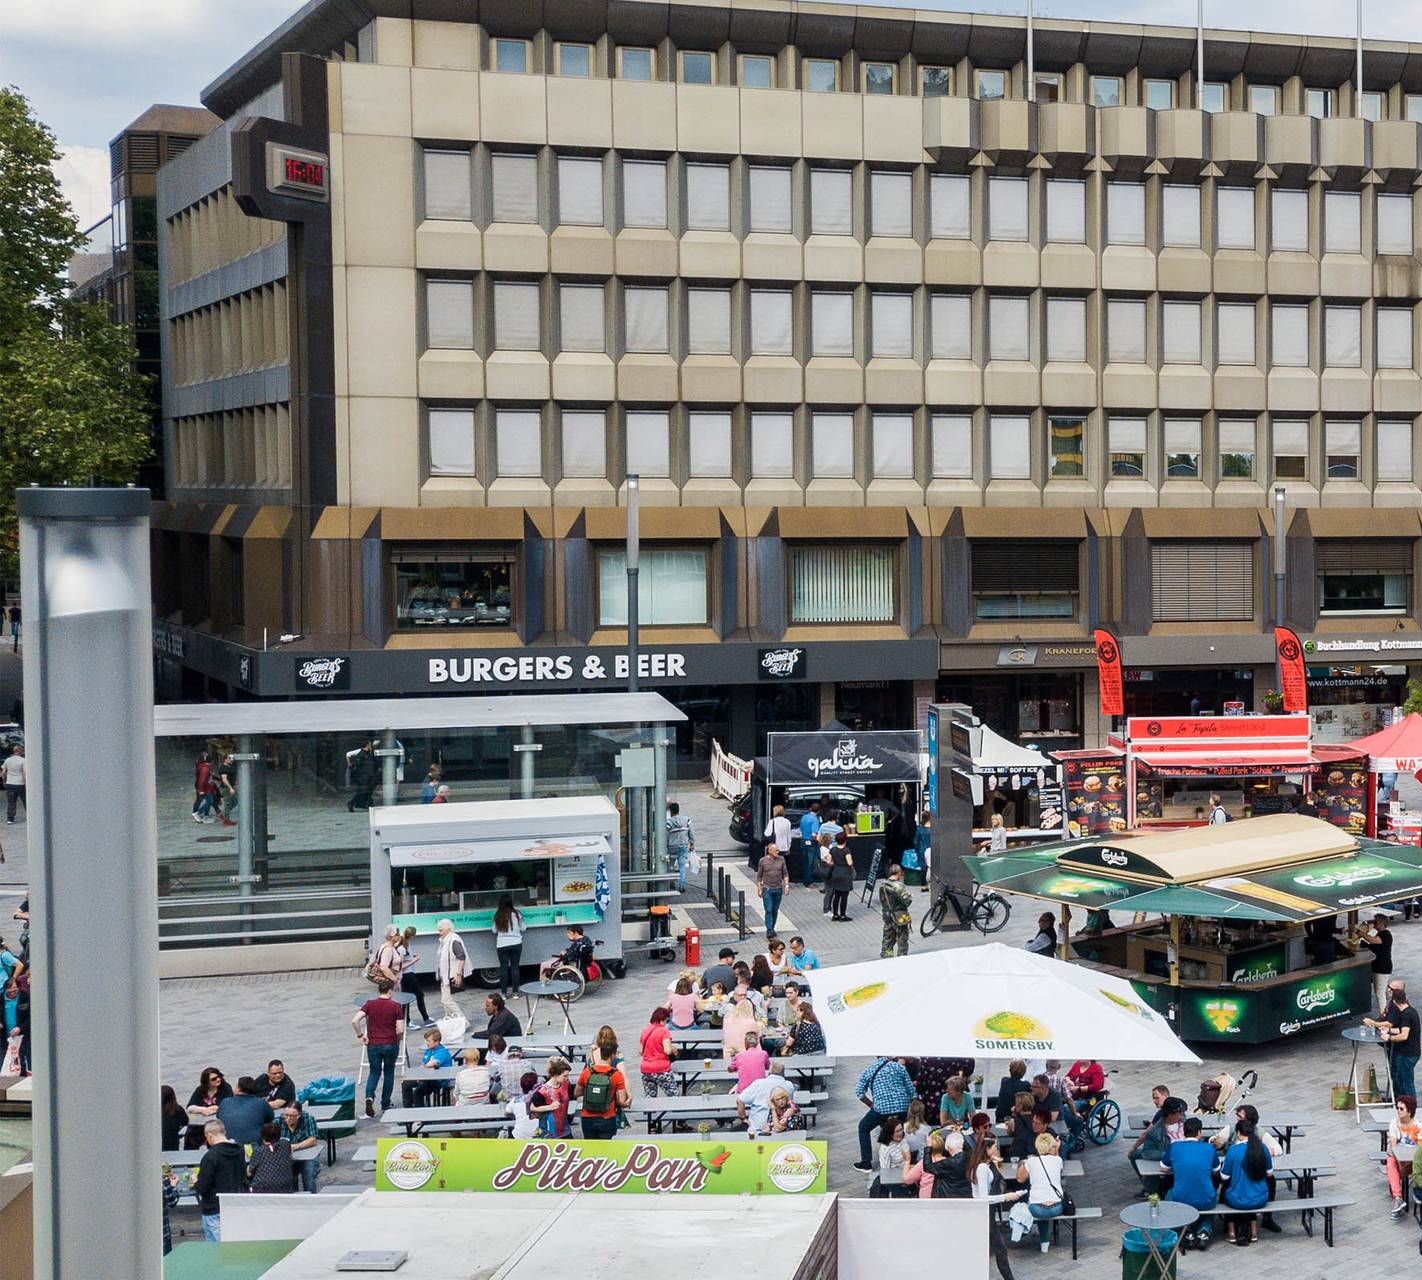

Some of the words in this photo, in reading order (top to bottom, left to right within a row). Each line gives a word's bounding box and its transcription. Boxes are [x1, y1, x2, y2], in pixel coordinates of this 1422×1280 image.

[1045, 647, 1097, 655] KRANEFOE
[1317, 640, 1379, 652] Buchhandlung
[429, 655, 573, 682] BURGERS
[582, 656, 606, 678] &
[615, 653, 687, 678] BEER
[769, 661, 794, 674] BEER
[307, 671, 335, 685] BEER
[1307, 677, 1388, 687] ww.kottmann24.de
[1214, 767, 1232, 775] Pulled
[1101, 848, 1128, 866] Carlsberg
[1293, 867, 1391, 887] Carlsberg
[1297, 985, 1335, 1012] Carlsberg
[1280, 1020, 1300, 1035] Carlsberg
[974, 1039, 1054, 1051] SOMERSBY
[390, 1161, 409, 1171] Pita
[412, 1162, 433, 1171] Pan
[493, 1142, 604, 1191] Pita
[598, 1142, 709, 1191] Pan
[772, 1164, 793, 1174] Pita
[796, 1164, 815, 1173] Pan
